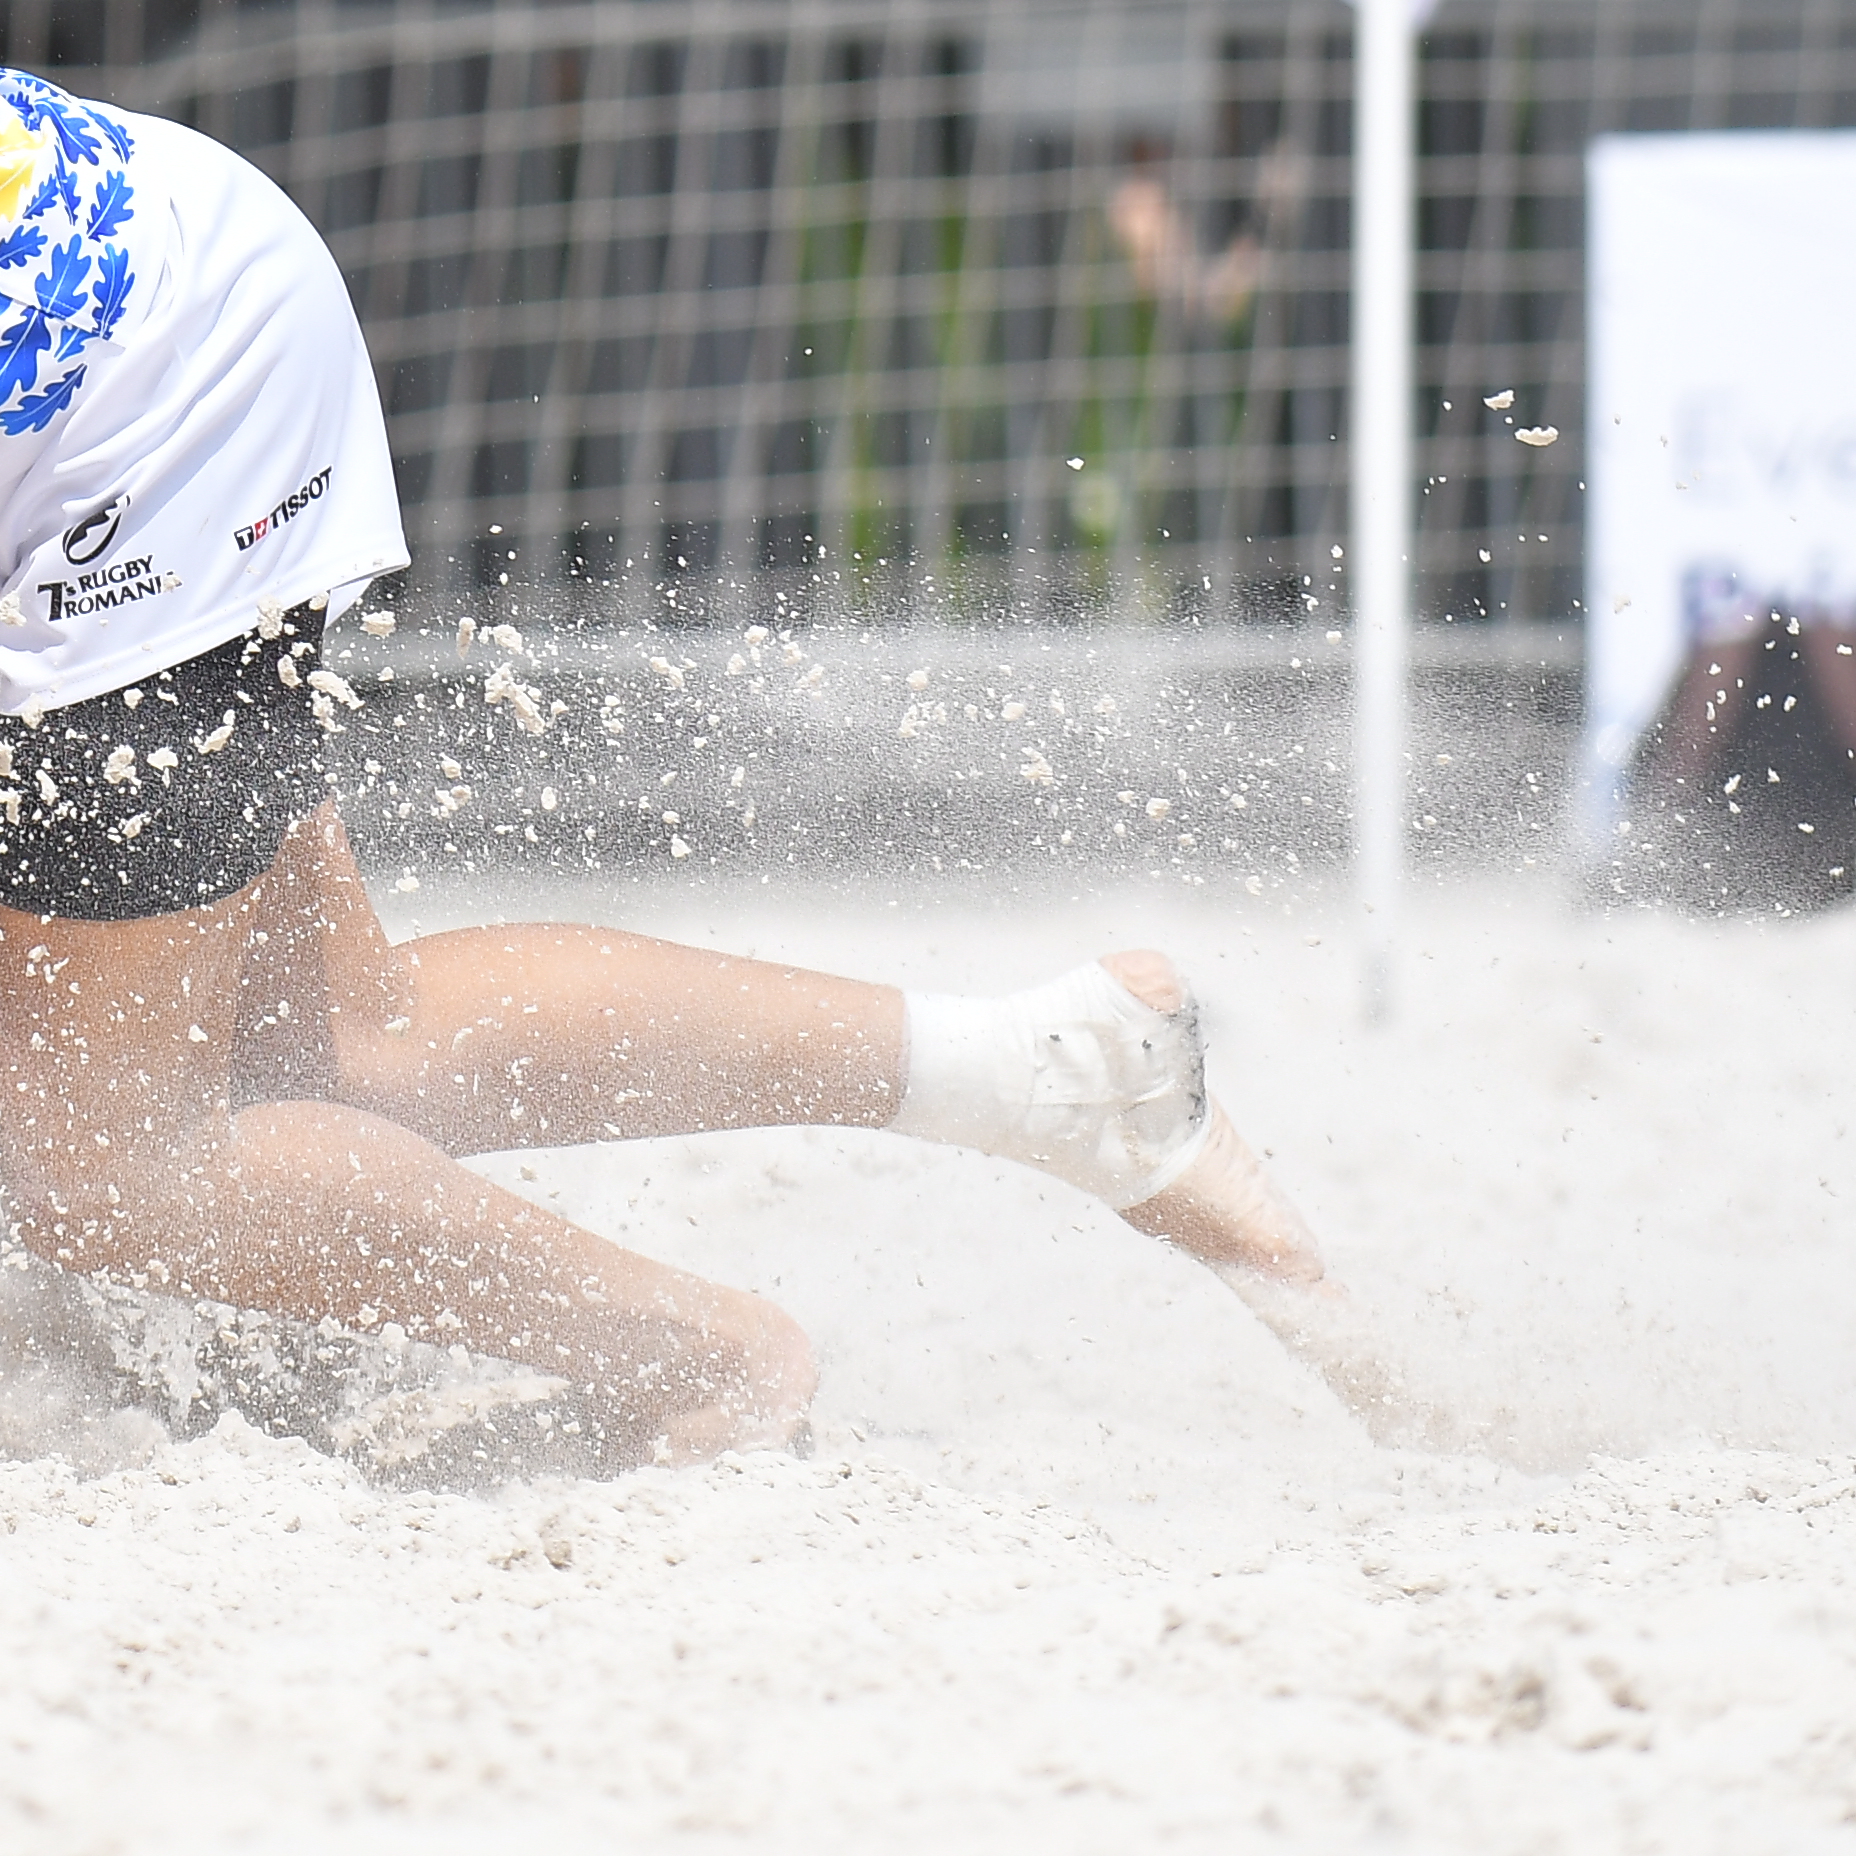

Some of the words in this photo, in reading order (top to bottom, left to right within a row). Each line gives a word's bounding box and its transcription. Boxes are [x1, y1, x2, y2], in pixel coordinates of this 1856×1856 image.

[269, 465, 332, 530] TISSOT
[63, 570, 183, 619] ROMANI
[77, 554, 153, 594] RUGBY
